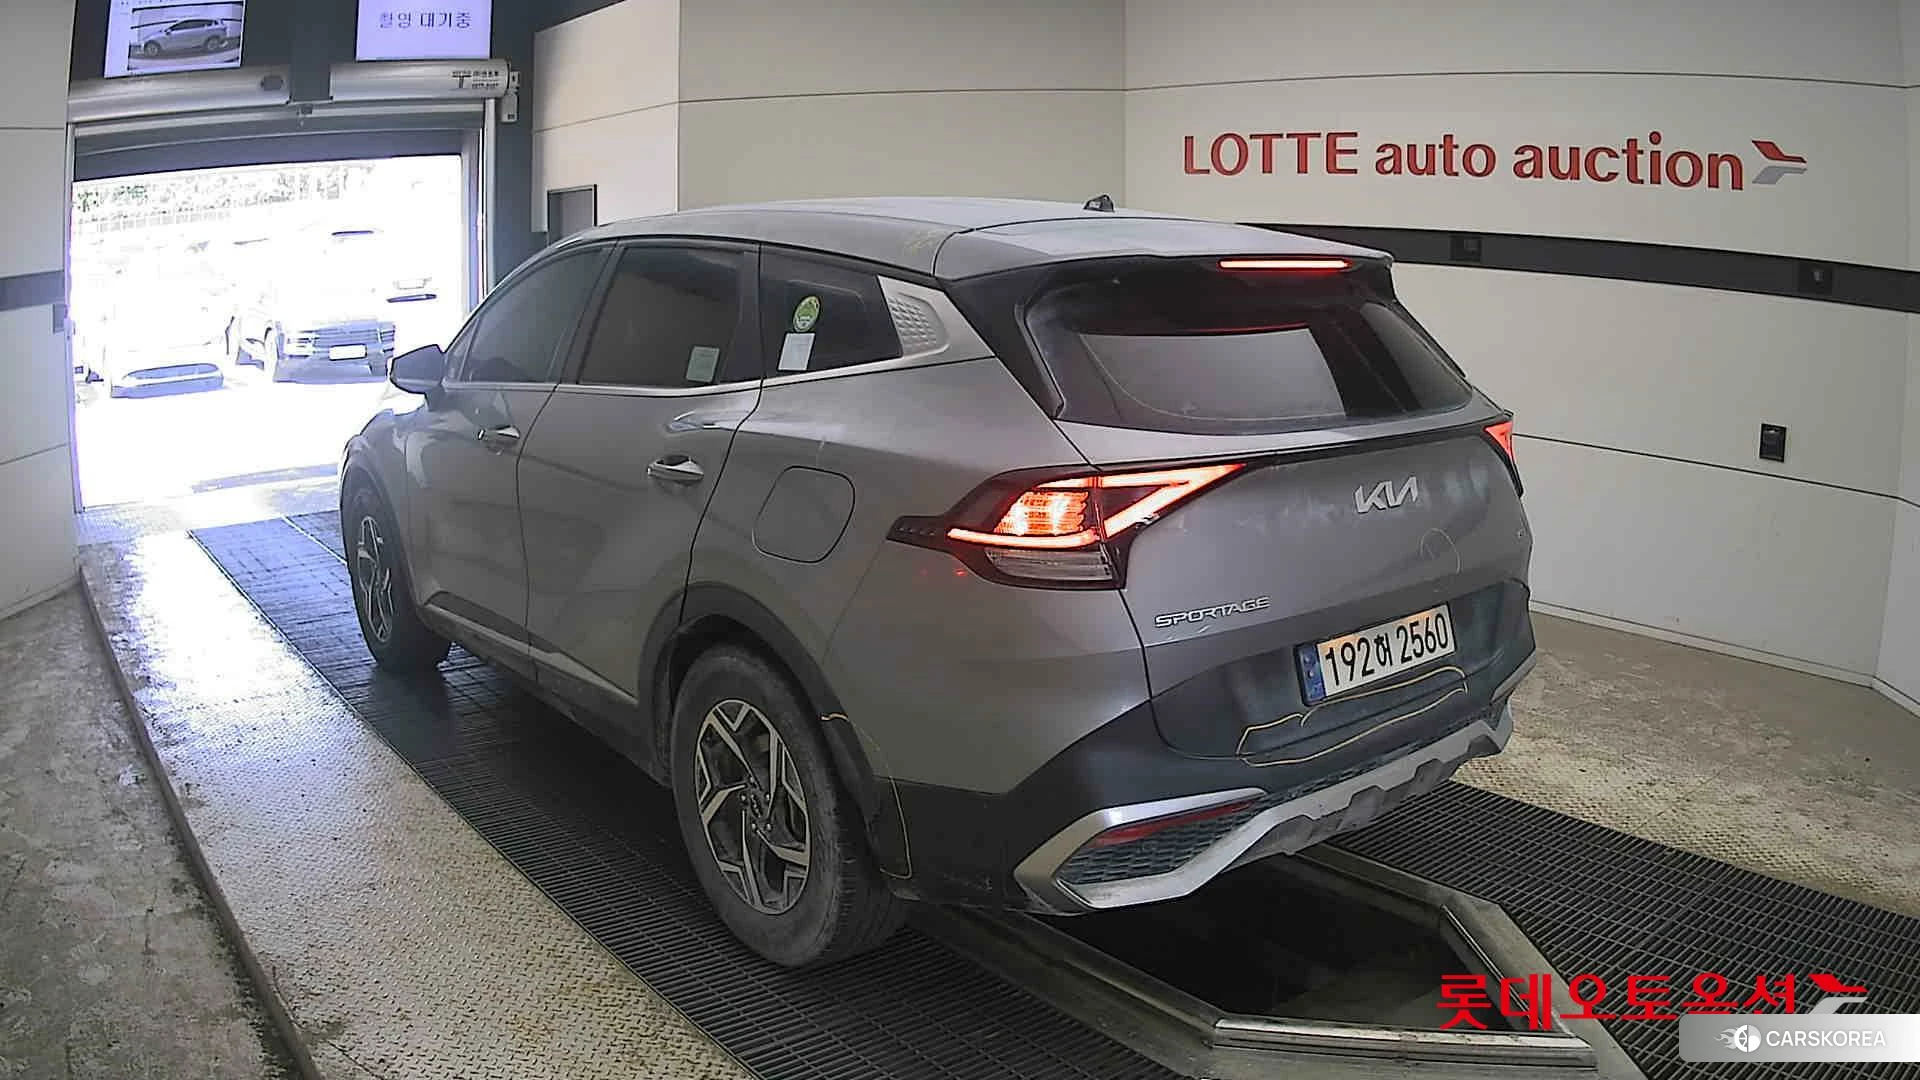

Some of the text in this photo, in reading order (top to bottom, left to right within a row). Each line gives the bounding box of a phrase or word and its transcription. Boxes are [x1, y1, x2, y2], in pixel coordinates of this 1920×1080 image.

[420, 12, 472, 29] 대기중
[1184, 130, 1744, 191] LOTTE auto auction
[1154, 596, 1273, 628] SPORTAGE
[1324, 613, 1449, 686] 192허 2560
